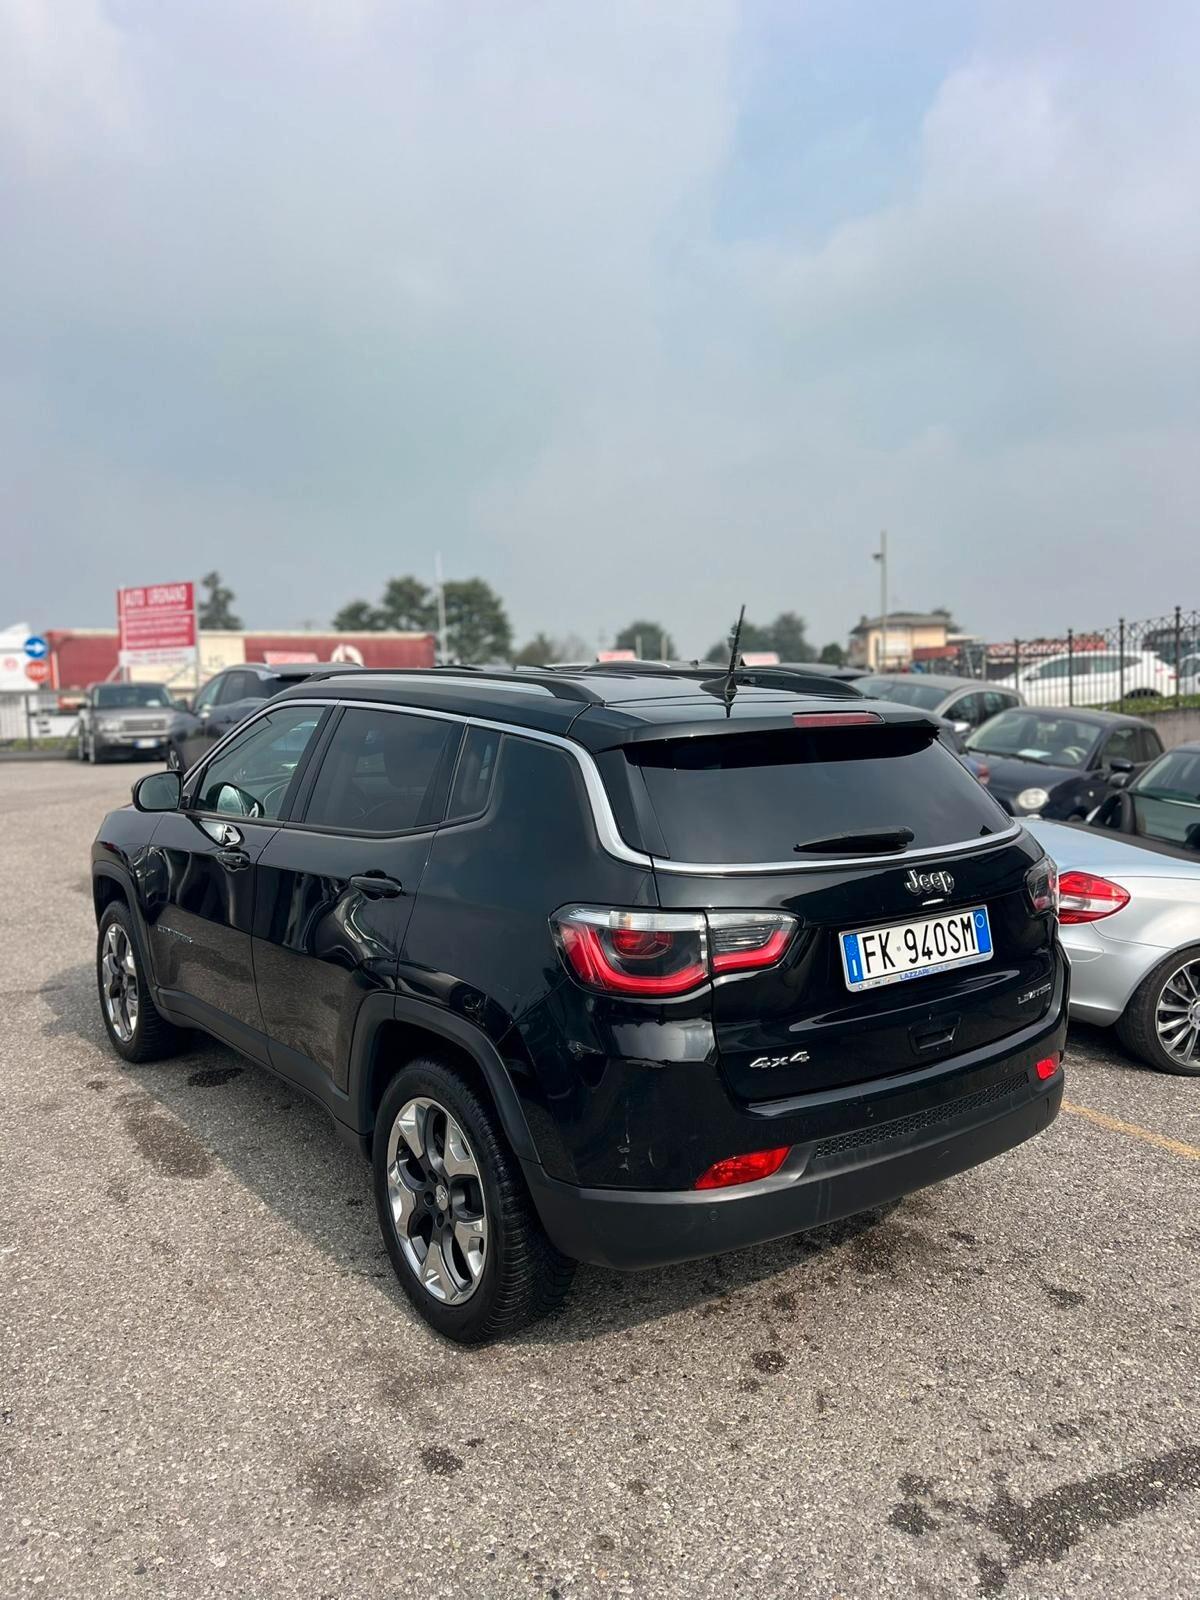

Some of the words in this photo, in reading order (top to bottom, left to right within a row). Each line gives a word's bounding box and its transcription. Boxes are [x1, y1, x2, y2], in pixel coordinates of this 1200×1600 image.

[904, 869, 954, 894] Jeep
[862, 931, 896, 974] FK
[904, 915, 977, 964] 940SM
